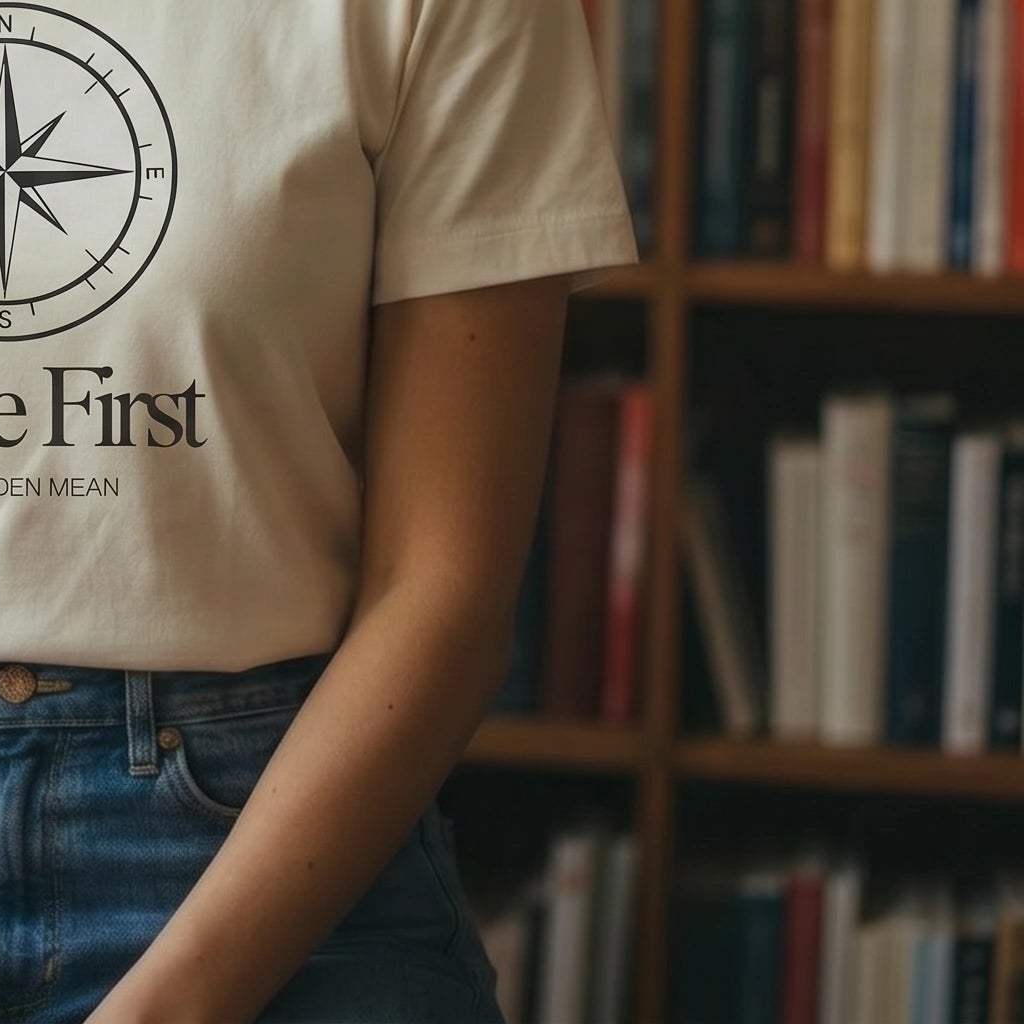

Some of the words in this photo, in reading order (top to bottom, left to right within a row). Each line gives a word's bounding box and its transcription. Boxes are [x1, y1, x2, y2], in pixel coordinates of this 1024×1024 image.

[145, 166, 165, 180] E
[42, 365, 208, 449] First
[49, 476, 119, 497] MEAN
